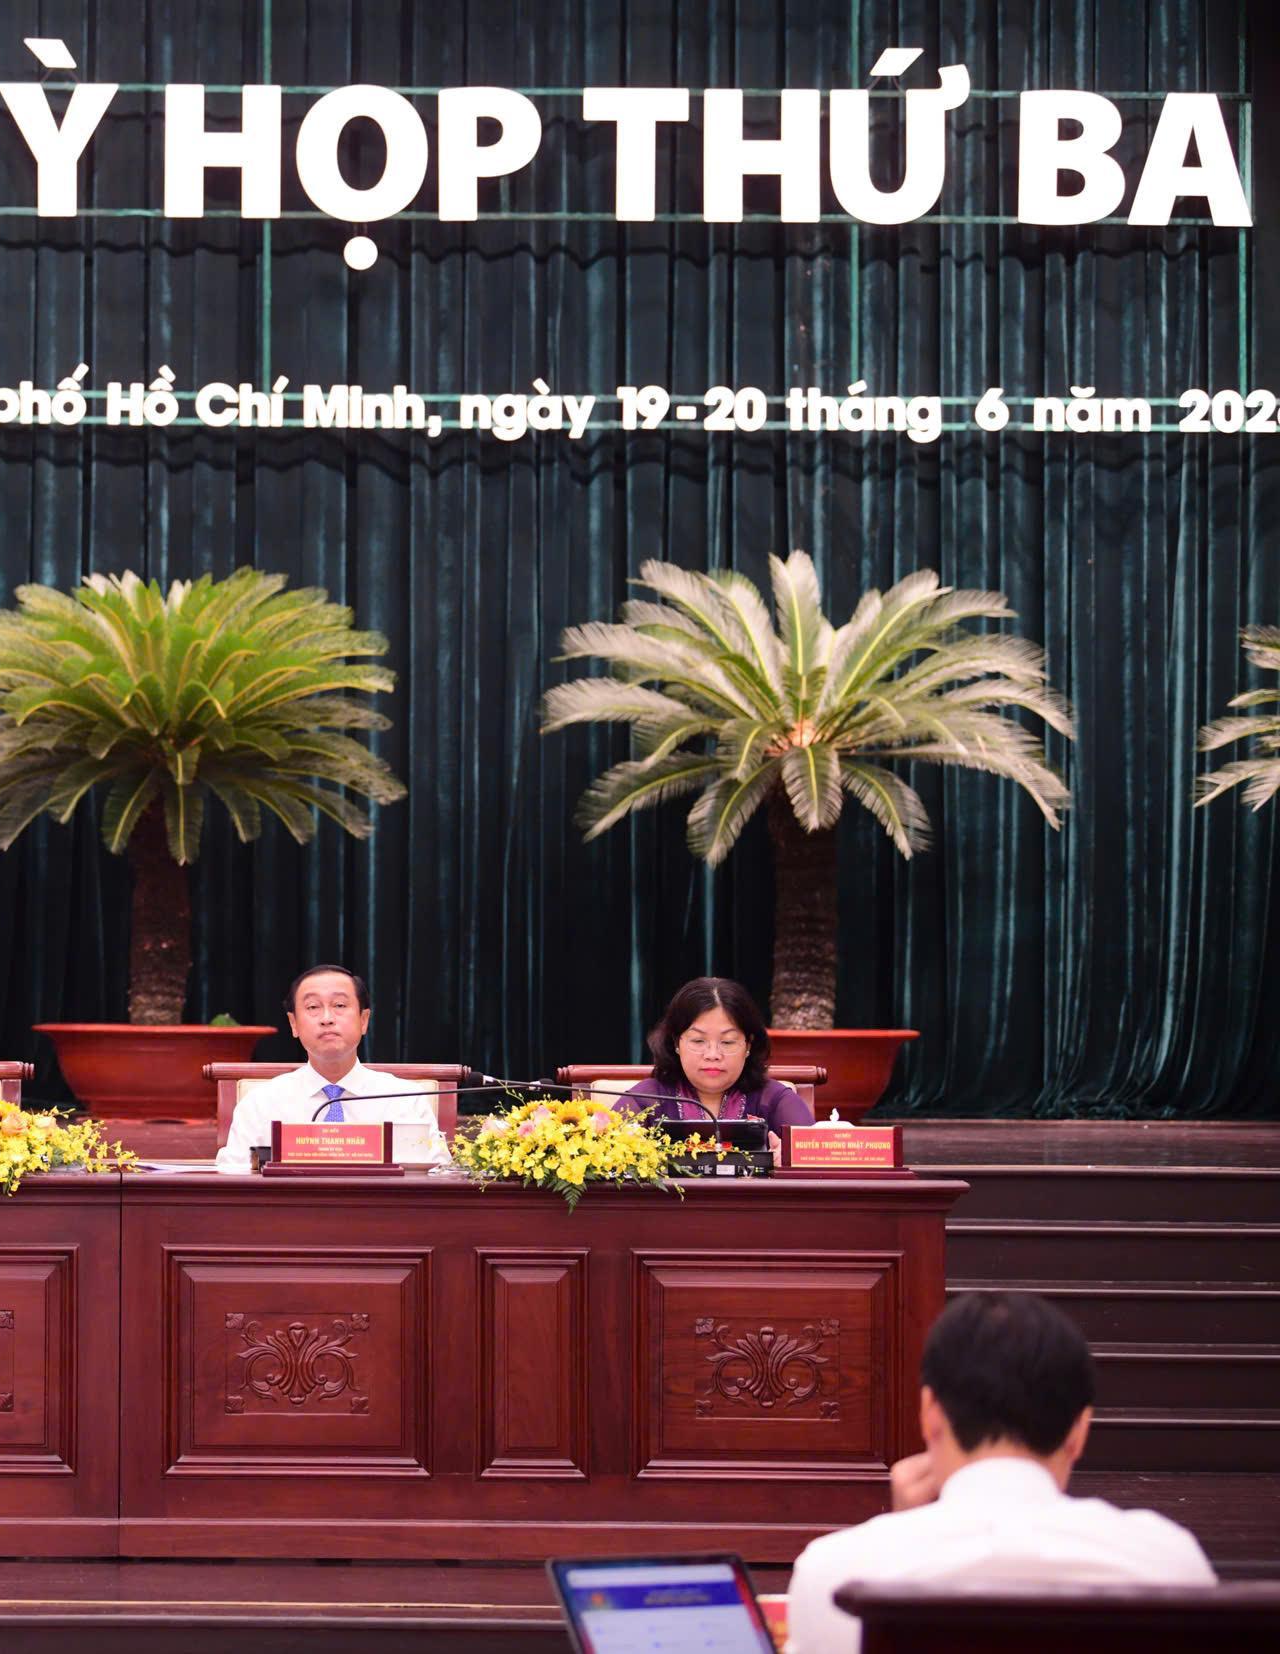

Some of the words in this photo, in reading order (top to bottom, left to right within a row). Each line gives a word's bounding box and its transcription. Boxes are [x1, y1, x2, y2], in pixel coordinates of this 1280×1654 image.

[164, 83, 542, 270] HỌP
[582, 47, 971, 225] THỨ
[1017, 89, 1253, 227] BA
[105, 364, 179, 427] Hồ
[195, 375, 289, 427] Chí
[302, 384, 443, 438] Minh,
[458, 378, 597, 441] ngày
[785, 379, 945, 444] tháng
[974, 387, 1010, 432] 6
[1032, 386, 1152, 433] năm
[1177, 388, 1280, 433] 202
